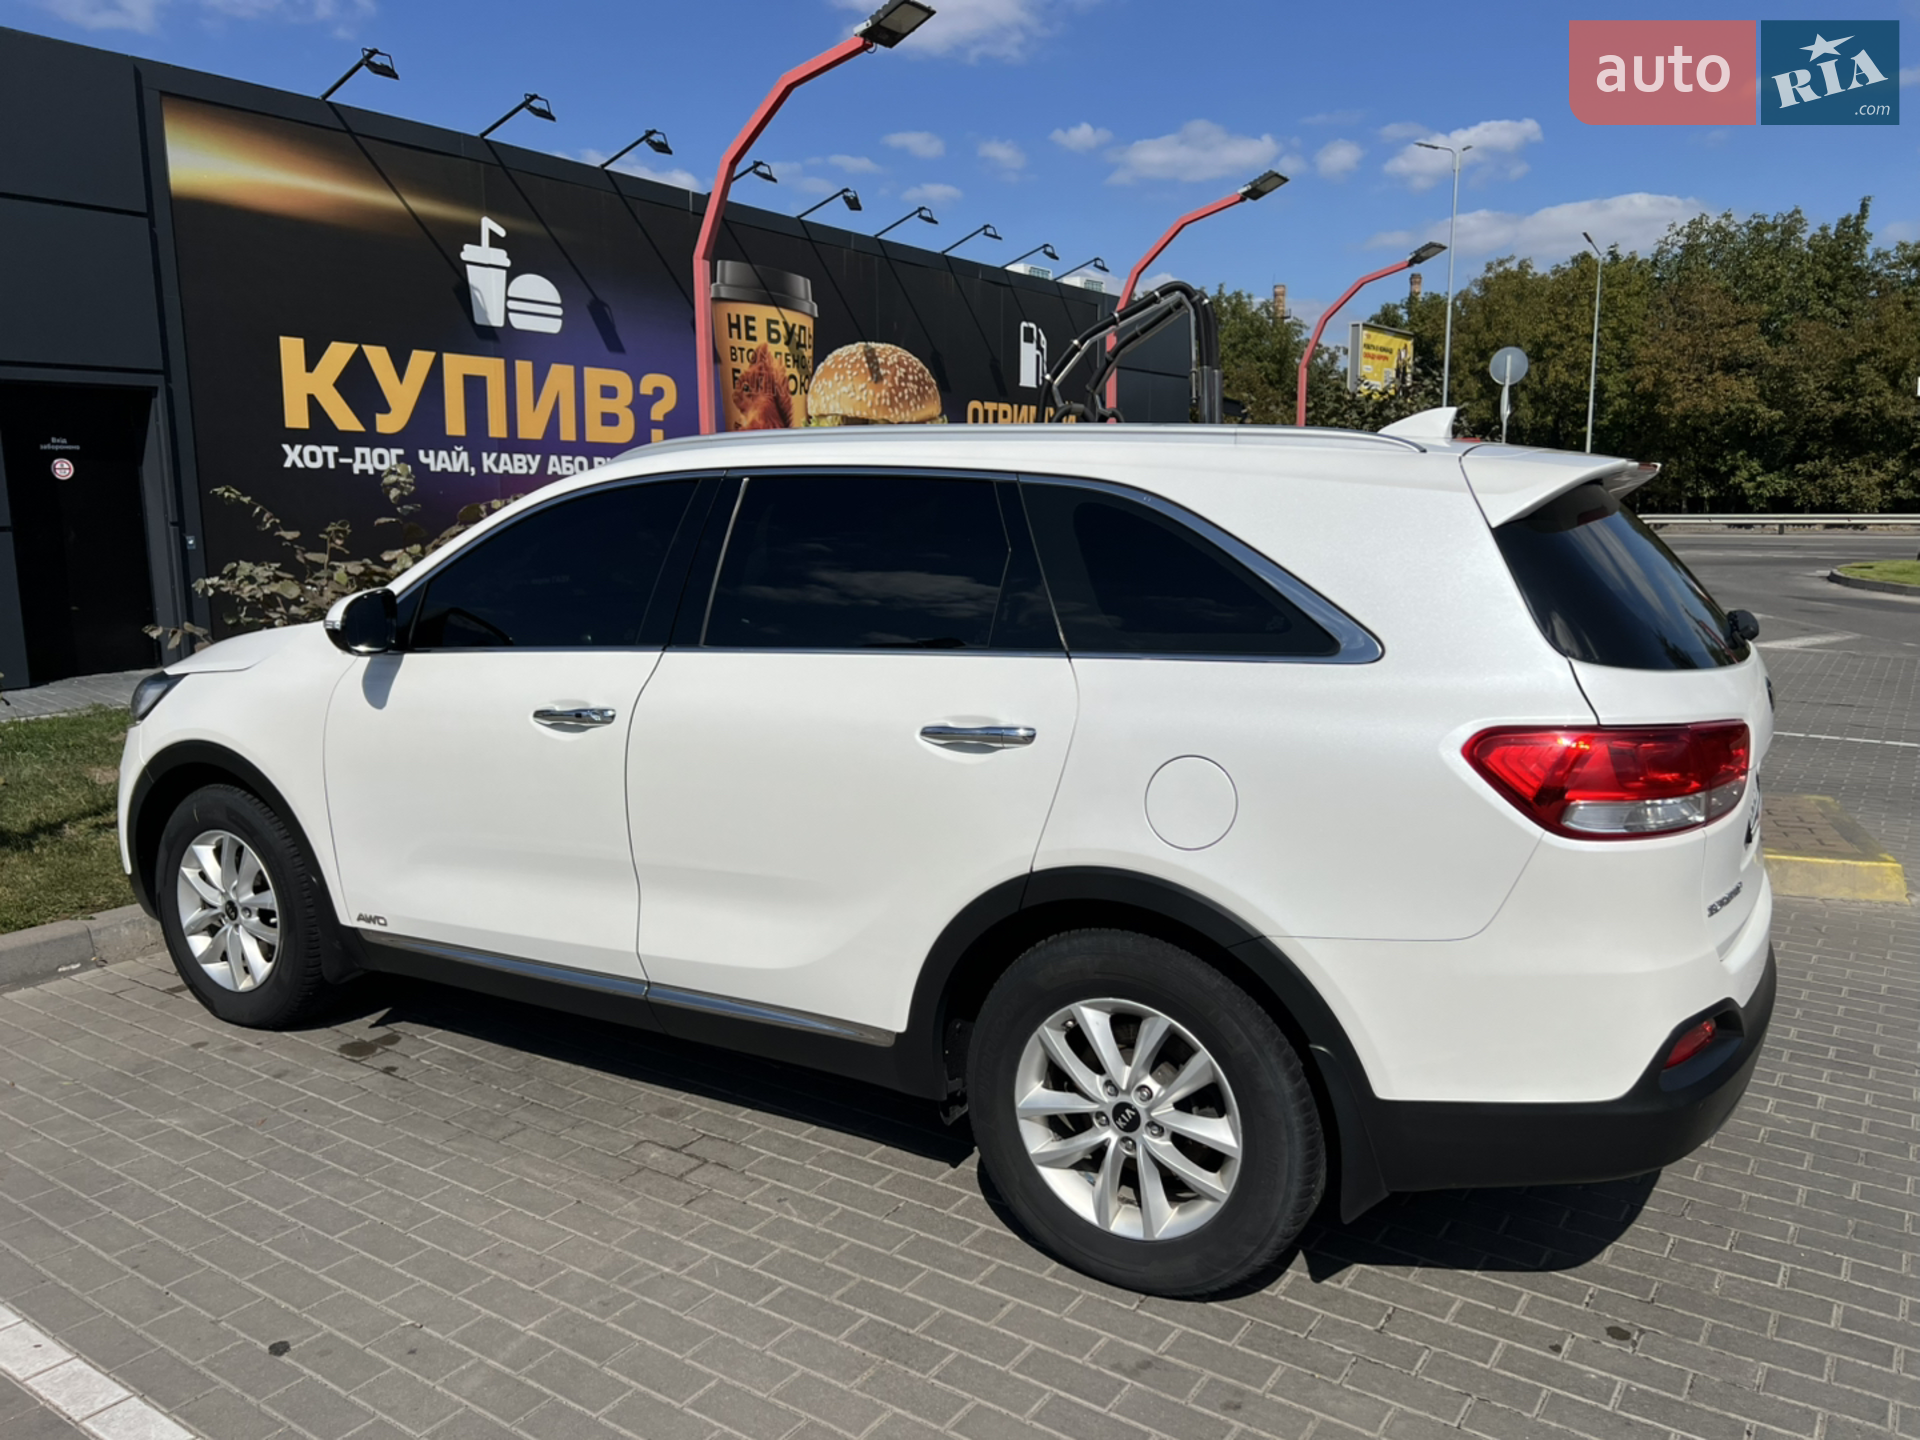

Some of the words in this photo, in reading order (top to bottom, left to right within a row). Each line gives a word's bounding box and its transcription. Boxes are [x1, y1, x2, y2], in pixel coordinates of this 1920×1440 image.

[727, 312, 758, 342] НЕ
[279, 335, 678, 444] КУПИВ?
[418, 445, 476, 476] ЧАЙ,
[481, 452, 541, 475] КАВУ
[547, 455, 588, 475] АБО
[1116, 1108, 1136, 1129] KIA
